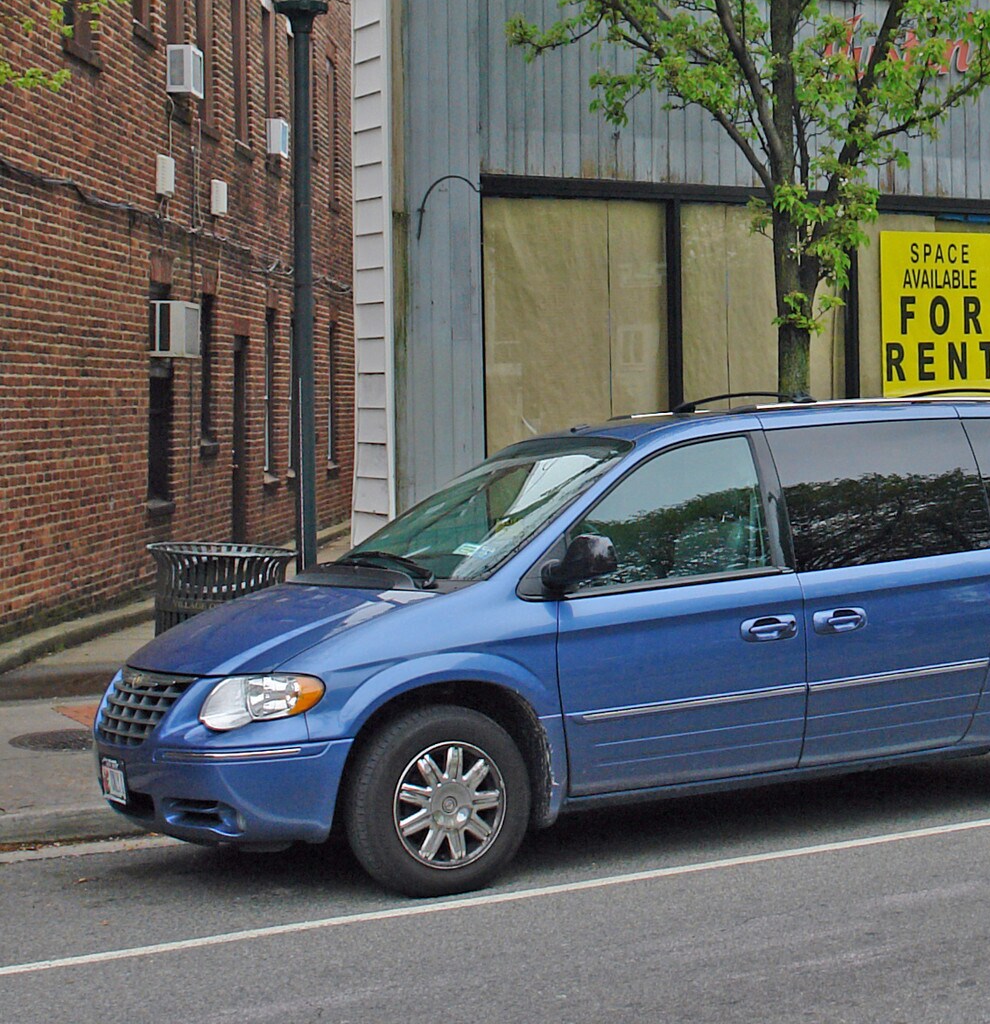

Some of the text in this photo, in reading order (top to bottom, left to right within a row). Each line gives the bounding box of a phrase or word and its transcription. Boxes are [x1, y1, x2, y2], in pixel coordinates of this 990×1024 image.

[910, 243, 970, 264] SPACE
[903, 269, 977, 289] AVAILABLE
[900, 295, 983, 336] FOR
